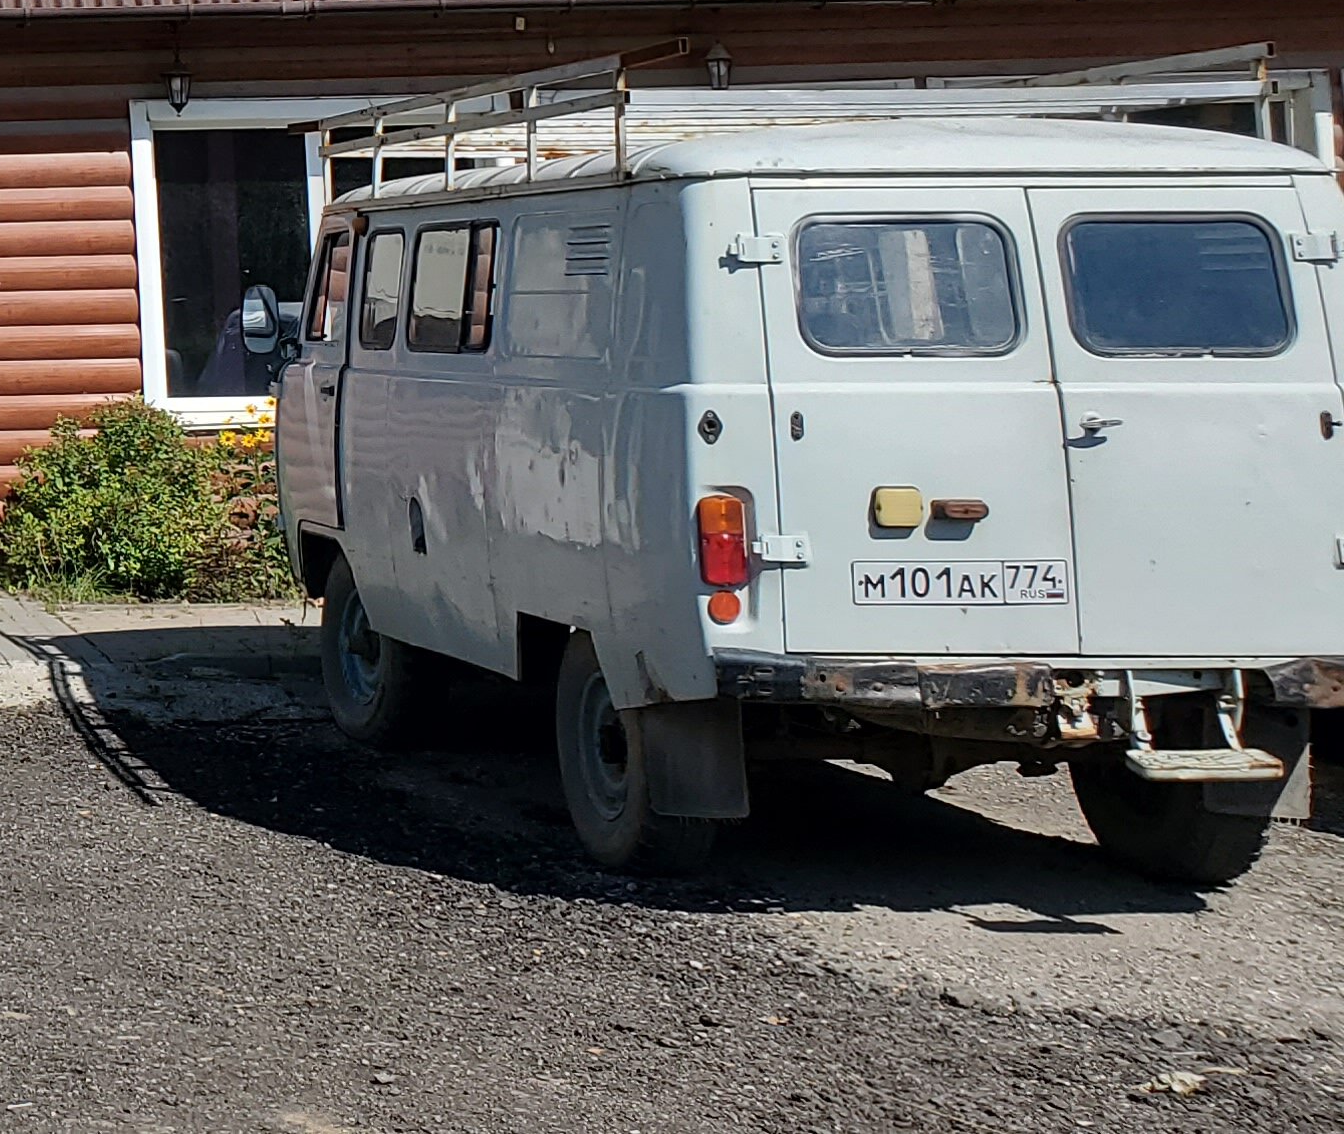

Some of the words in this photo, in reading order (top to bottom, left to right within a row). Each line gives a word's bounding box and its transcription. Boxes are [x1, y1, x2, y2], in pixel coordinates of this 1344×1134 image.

[863, 566, 999, 599] М101АК
[1005, 564, 1057, 590] 774
[1020, 589, 1045, 599] RUS
